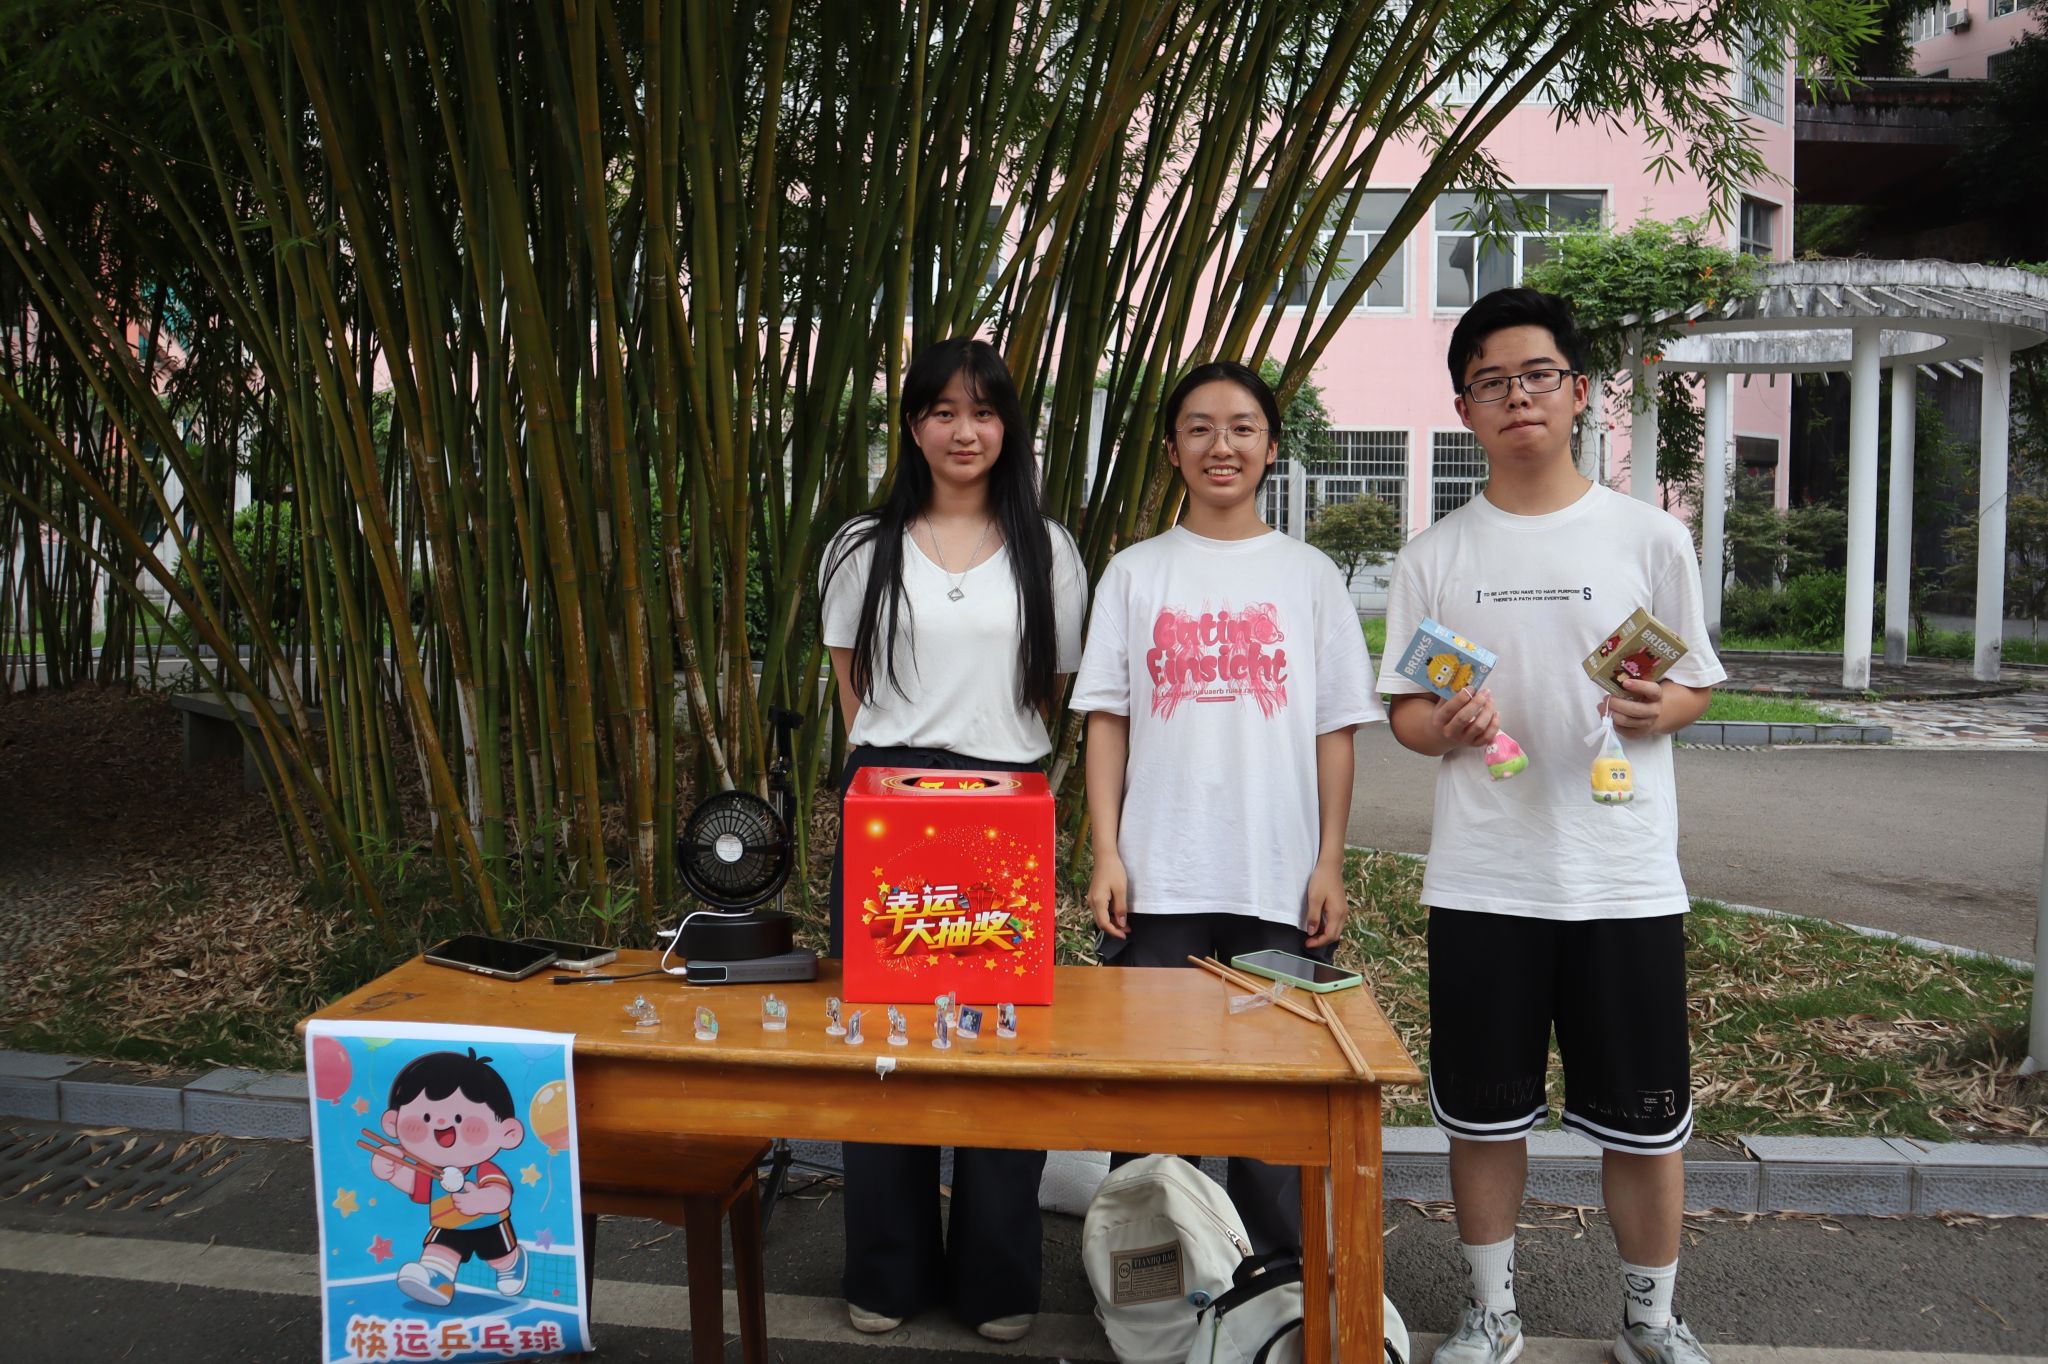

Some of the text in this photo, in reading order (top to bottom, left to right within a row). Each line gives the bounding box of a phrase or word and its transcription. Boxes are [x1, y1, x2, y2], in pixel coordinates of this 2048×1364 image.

[1475, 590, 1482, 603] I
[1583, 587, 1592, 601] S
[1404, 635, 1432, 675] BRICKS
[1641, 629, 1680, 660] BRICKS
[874, 885, 966, 936] 幸运
[893, 910, 1015, 955] 大抽奖
[350, 1320, 561, 1359] 筷运乒乓球
